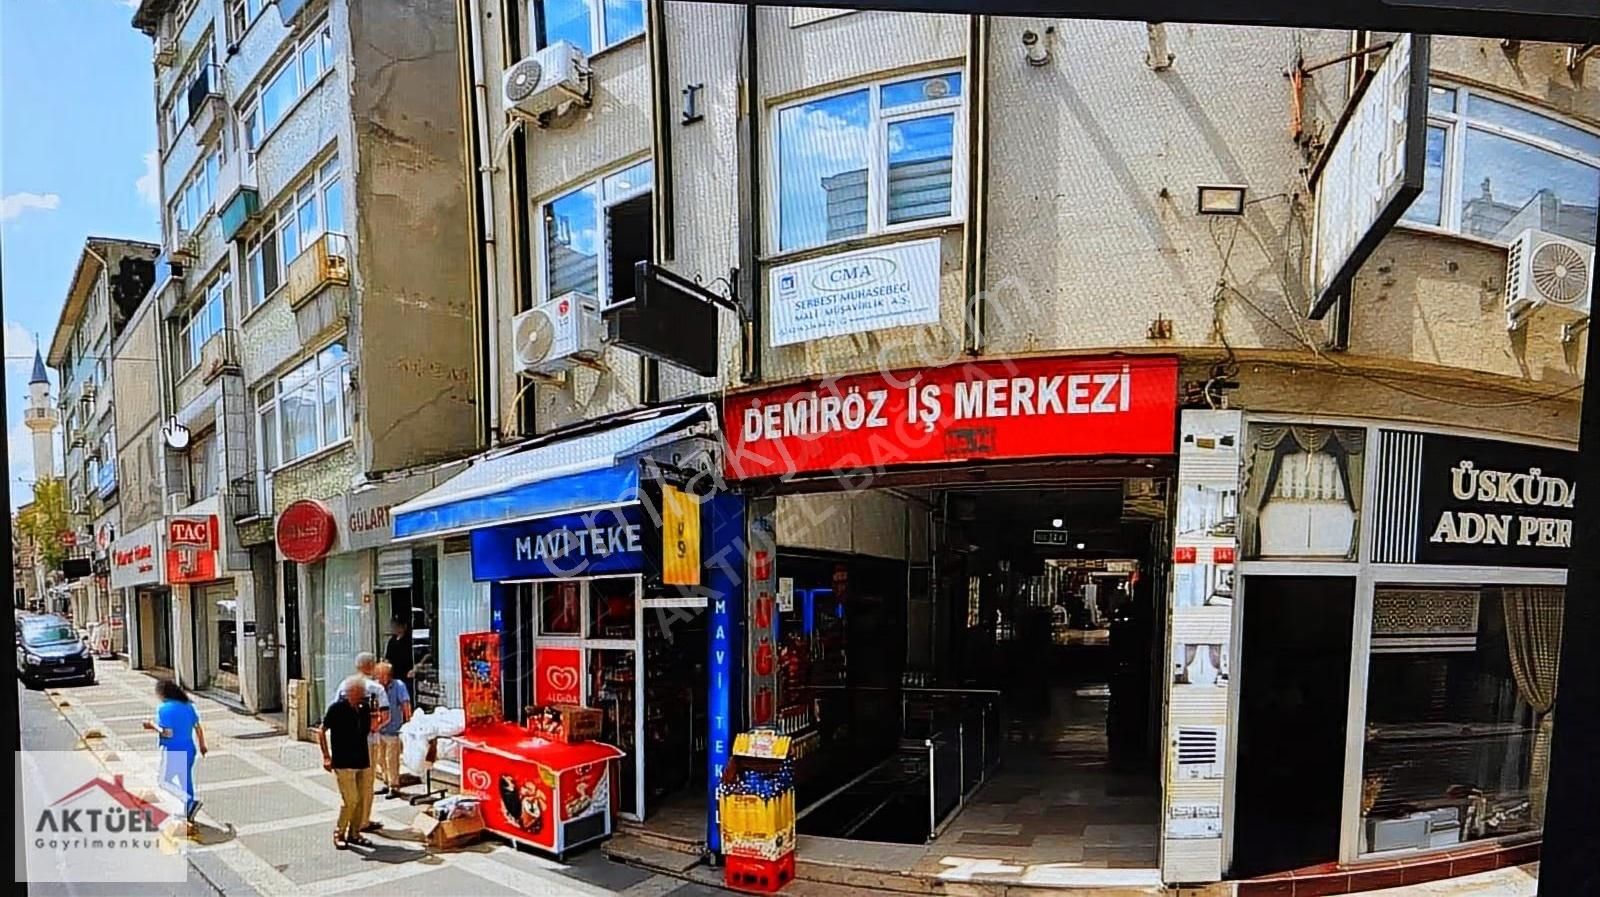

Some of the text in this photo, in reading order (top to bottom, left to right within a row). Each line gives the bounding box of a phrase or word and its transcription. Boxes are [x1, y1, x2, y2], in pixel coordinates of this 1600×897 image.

[829, 264, 873, 284] CMA
[794, 294, 838, 312] SERBEST
[743, 385, 889, 443] DEMİRÖZ
[907, 377, 943, 433] İŞ
[954, 363, 1131, 420] MERKEZİ
[516, 525, 570, 561] MAVİ
[1429, 510, 1513, 546] ADN
